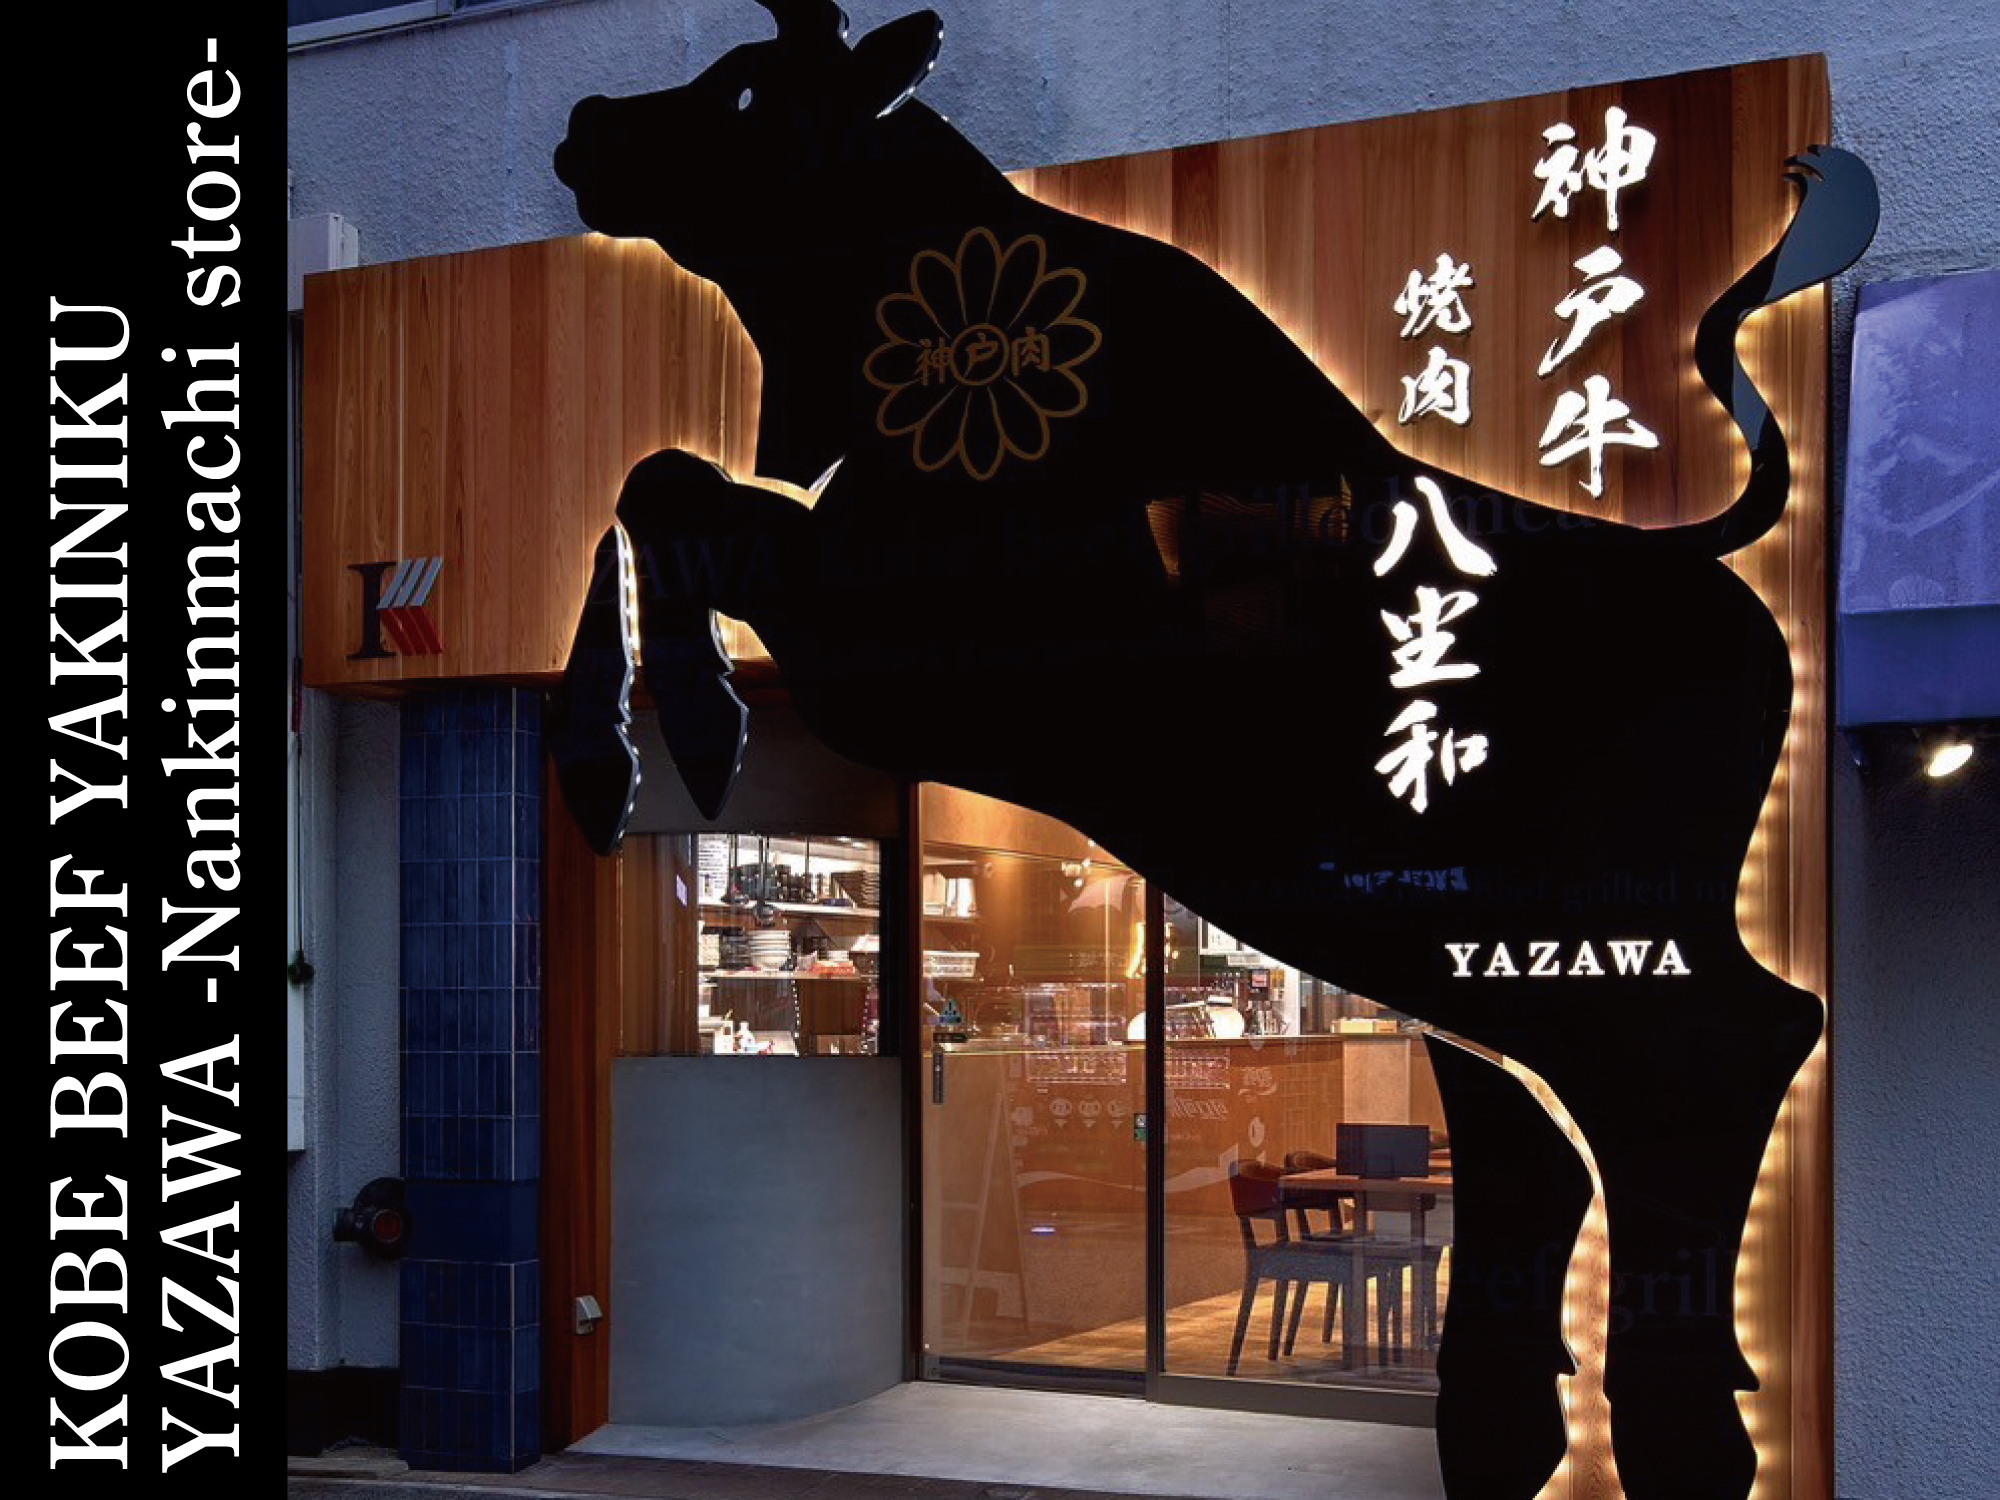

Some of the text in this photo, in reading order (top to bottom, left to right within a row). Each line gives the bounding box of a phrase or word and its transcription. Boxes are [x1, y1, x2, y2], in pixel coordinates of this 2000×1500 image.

[1532, 106, 1659, 498] 神戸牛
[1444, 939, 1692, 978] YAZAWA
